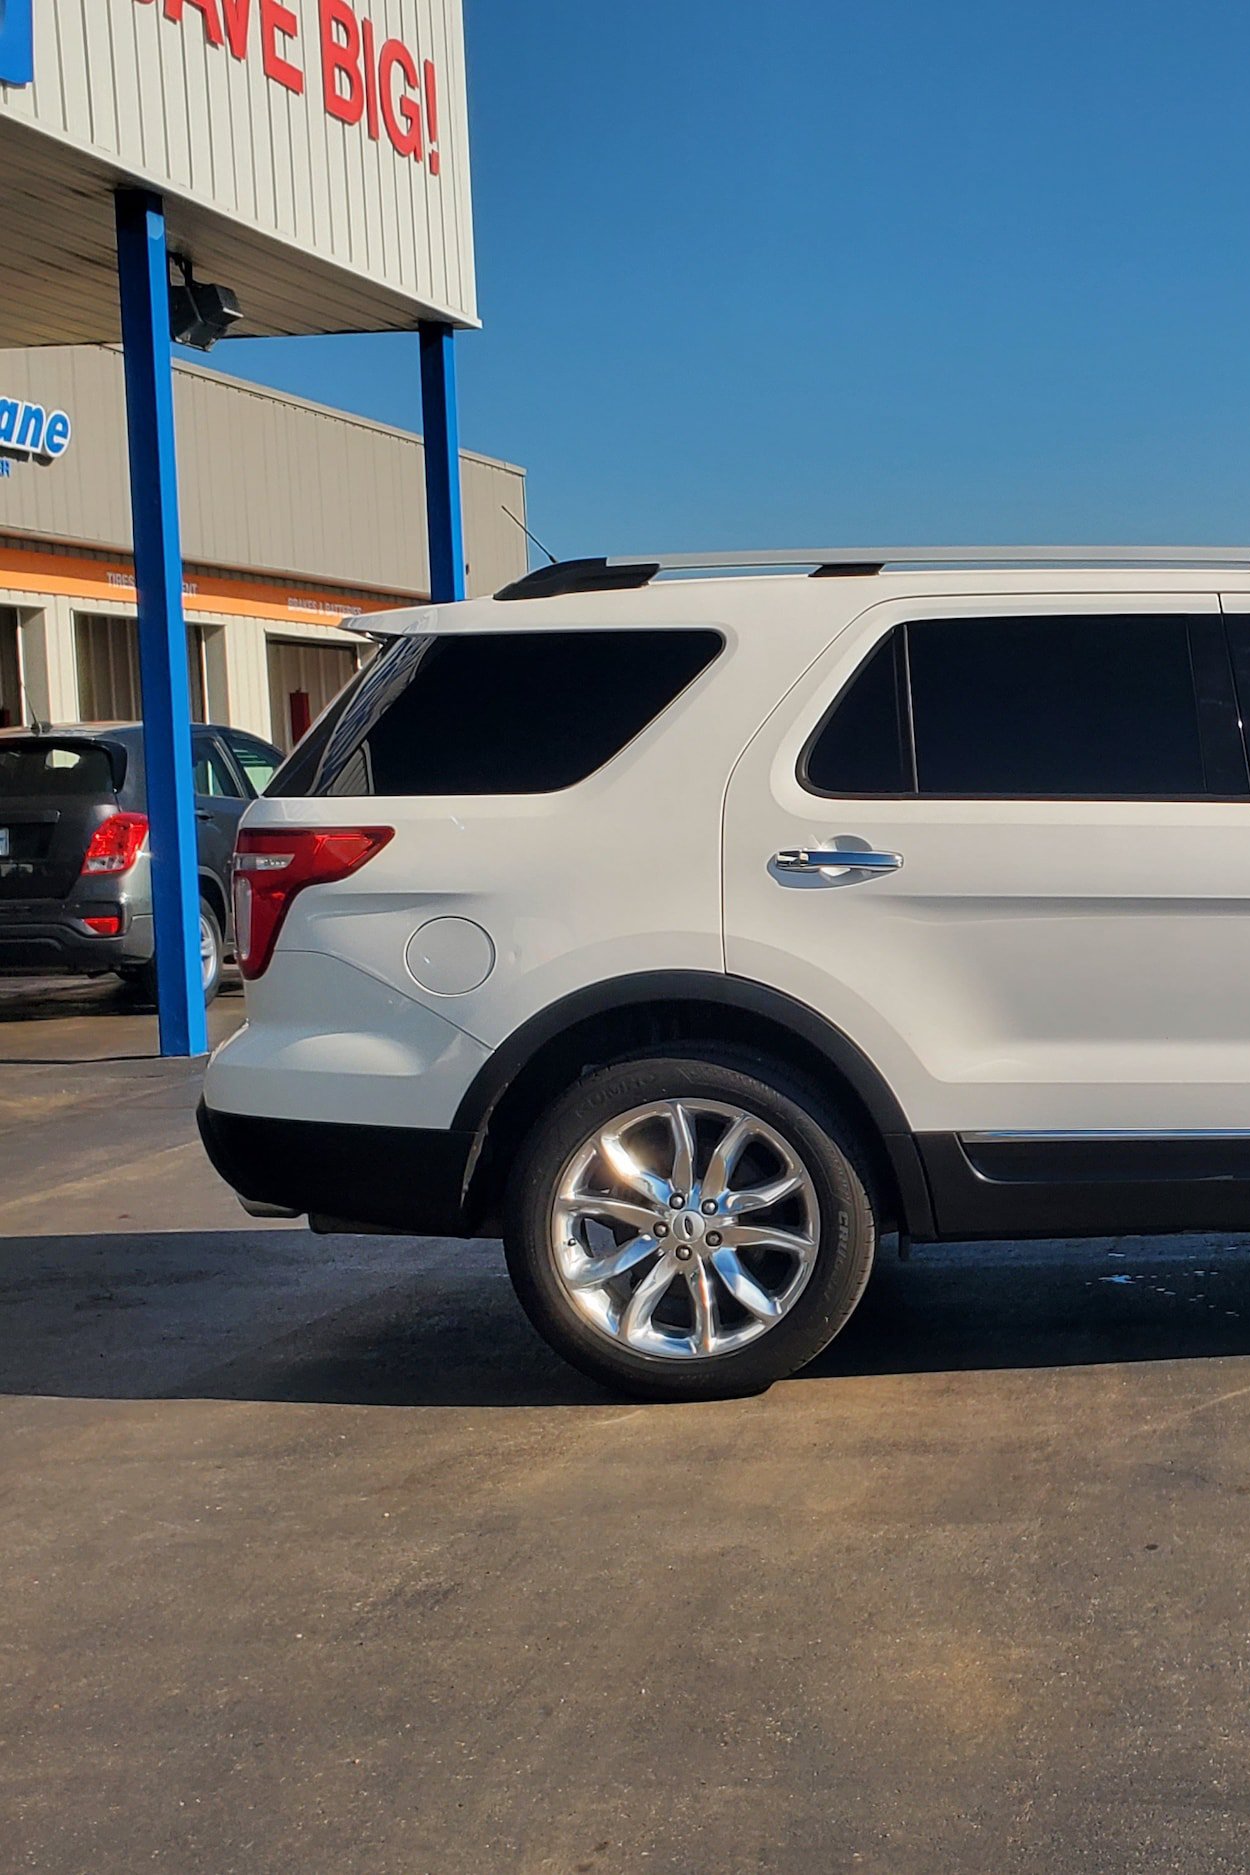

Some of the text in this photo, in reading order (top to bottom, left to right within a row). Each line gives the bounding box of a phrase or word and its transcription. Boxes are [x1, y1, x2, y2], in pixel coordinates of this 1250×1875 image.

[318, 0, 440, 176] BIG!
[106, 571, 136, 589] TIRES
[287, 597, 318, 614] BRAKES
